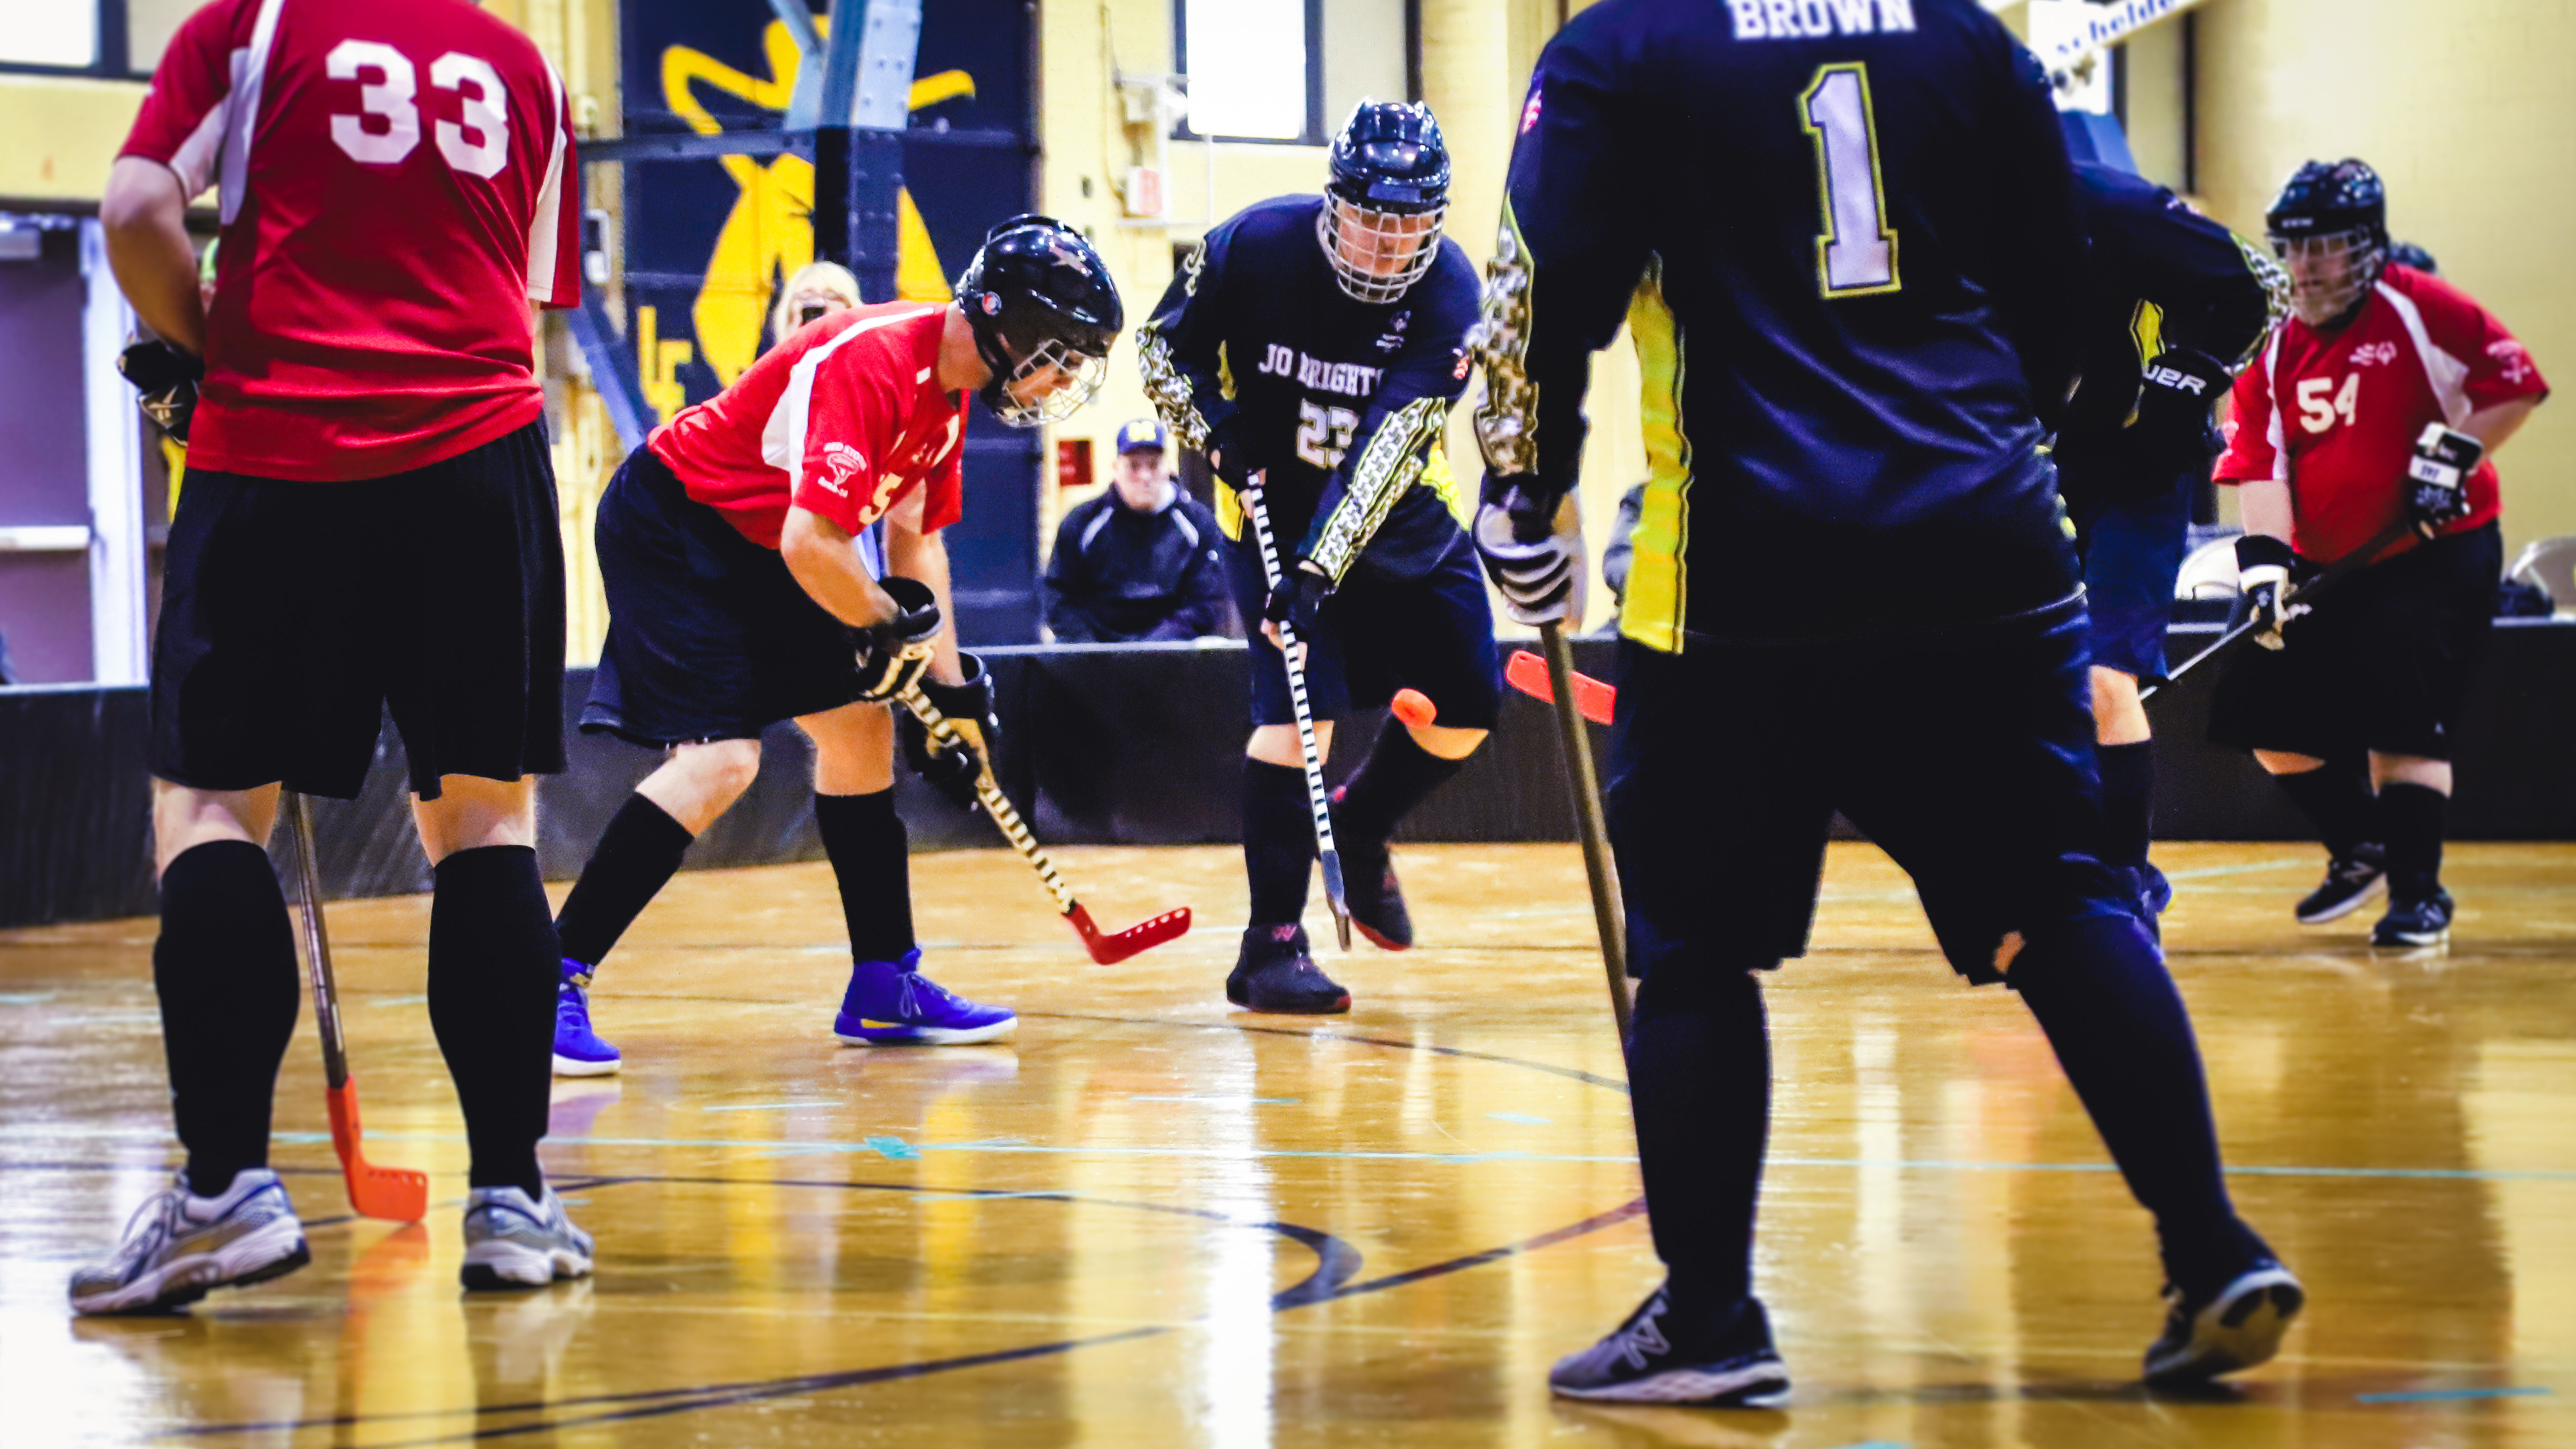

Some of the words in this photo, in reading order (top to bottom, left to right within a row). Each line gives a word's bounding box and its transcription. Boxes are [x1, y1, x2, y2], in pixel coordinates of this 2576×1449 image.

[1725, 0, 1918, 39] BROWN
[324, 38, 510, 180] 33
[1796, 60, 1902, 299] 1
[1258, 343, 1294, 377] JO
[2297, 372, 2360, 434] 54
